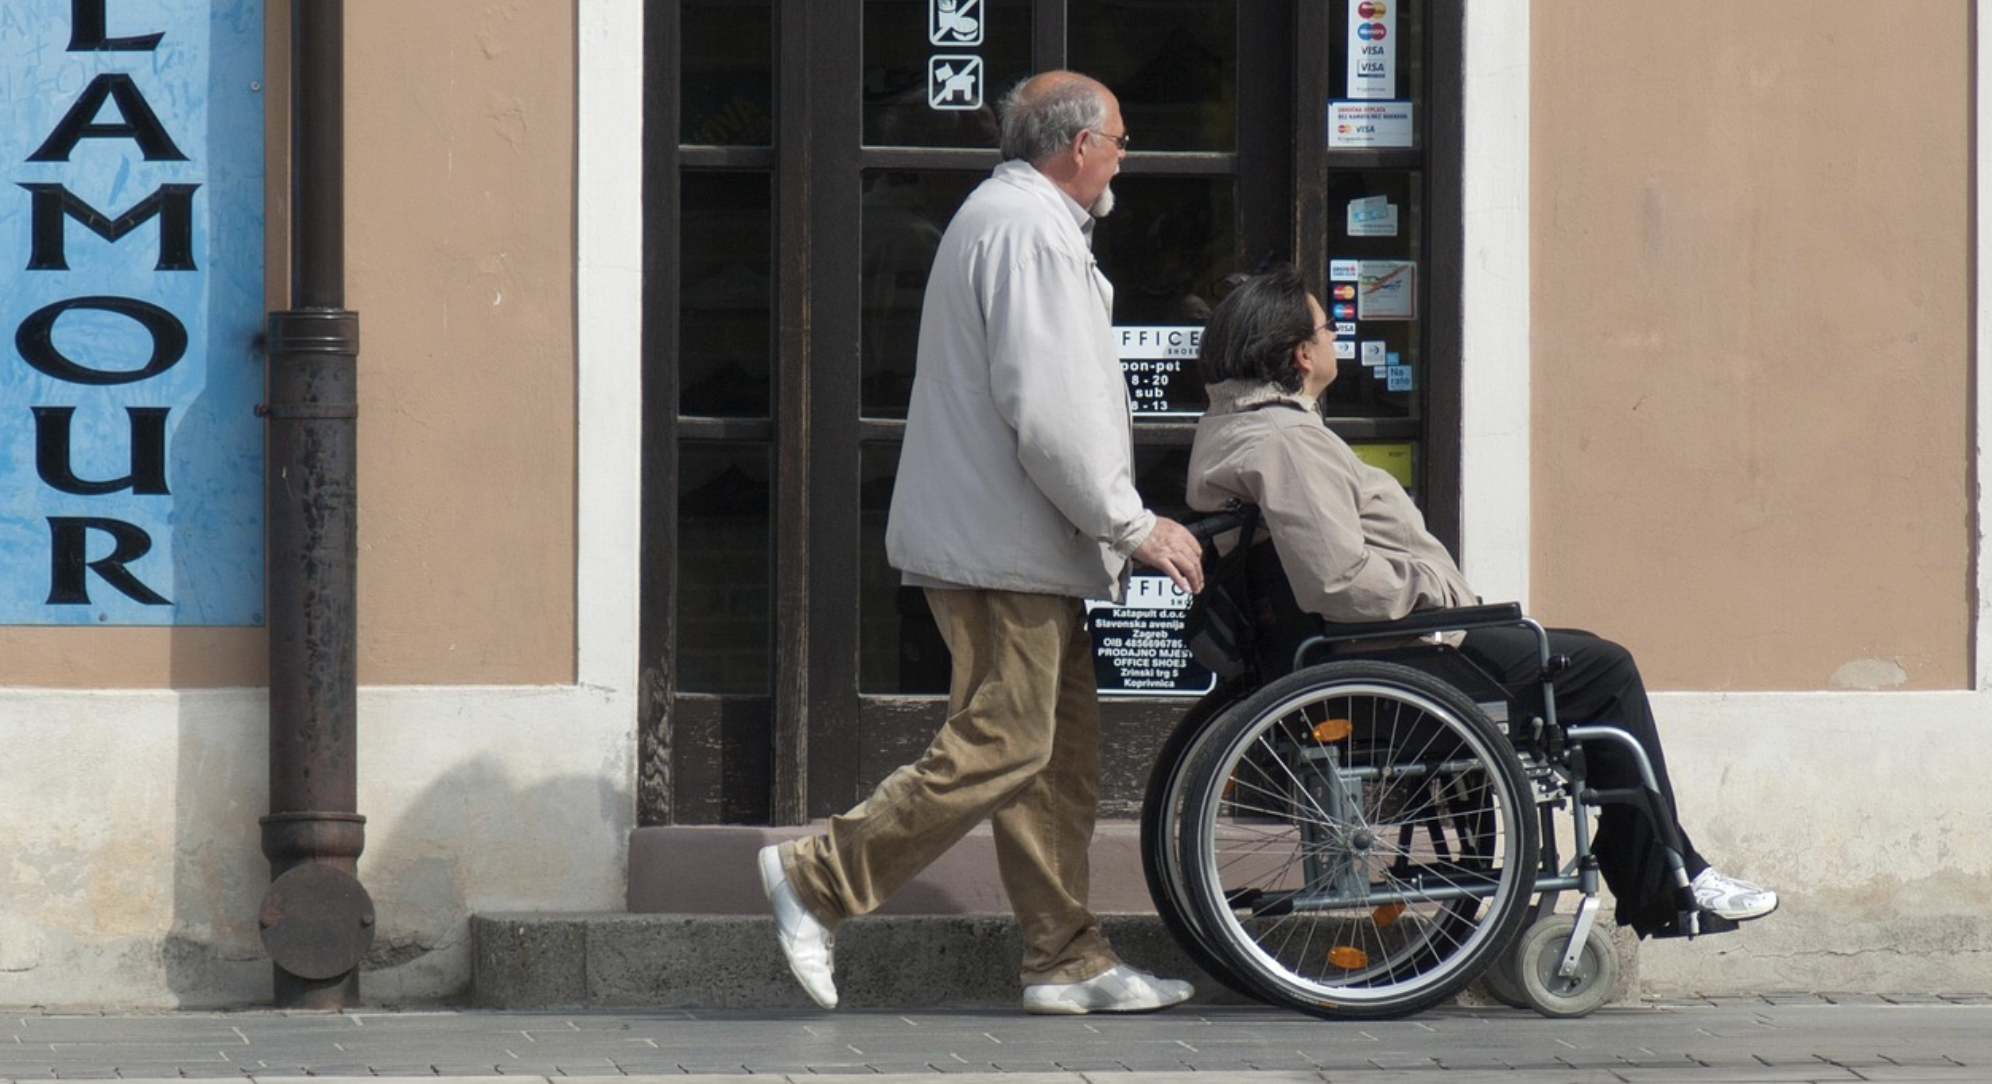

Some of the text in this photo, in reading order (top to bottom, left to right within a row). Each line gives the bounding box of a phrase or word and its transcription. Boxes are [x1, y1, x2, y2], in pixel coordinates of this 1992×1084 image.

[1361, 46, 1384, 55] VISA
[1361, 62, 1384, 72] VISA
[1356, 125, 1375, 133] VISA
[1122, 331, 1199, 346] FFICE
[1120, 361, 1180, 373] pon-pet
[1390, 368, 1404, 376] Na
[1131, 375, 1139, 385] 8
[1153, 375, 1168, 385] 20
[1135, 387, 1163, 398] sub
[1152, 400, 1168, 410] 13
[1112, 609, 1157, 620] Katapult
[1095, 619, 1185, 632] Slavonska avenija
[1132, 629, 1168, 639] Zagreb
[1103, 638, 1122, 647] OIB
[1098, 648, 1157, 658] PRODAJNO
[1113, 658, 1150, 668] OFFICE
[1119, 668, 1179, 679] Zrinski trg 5
[1123, 678, 1176, 689] Koprivnica
